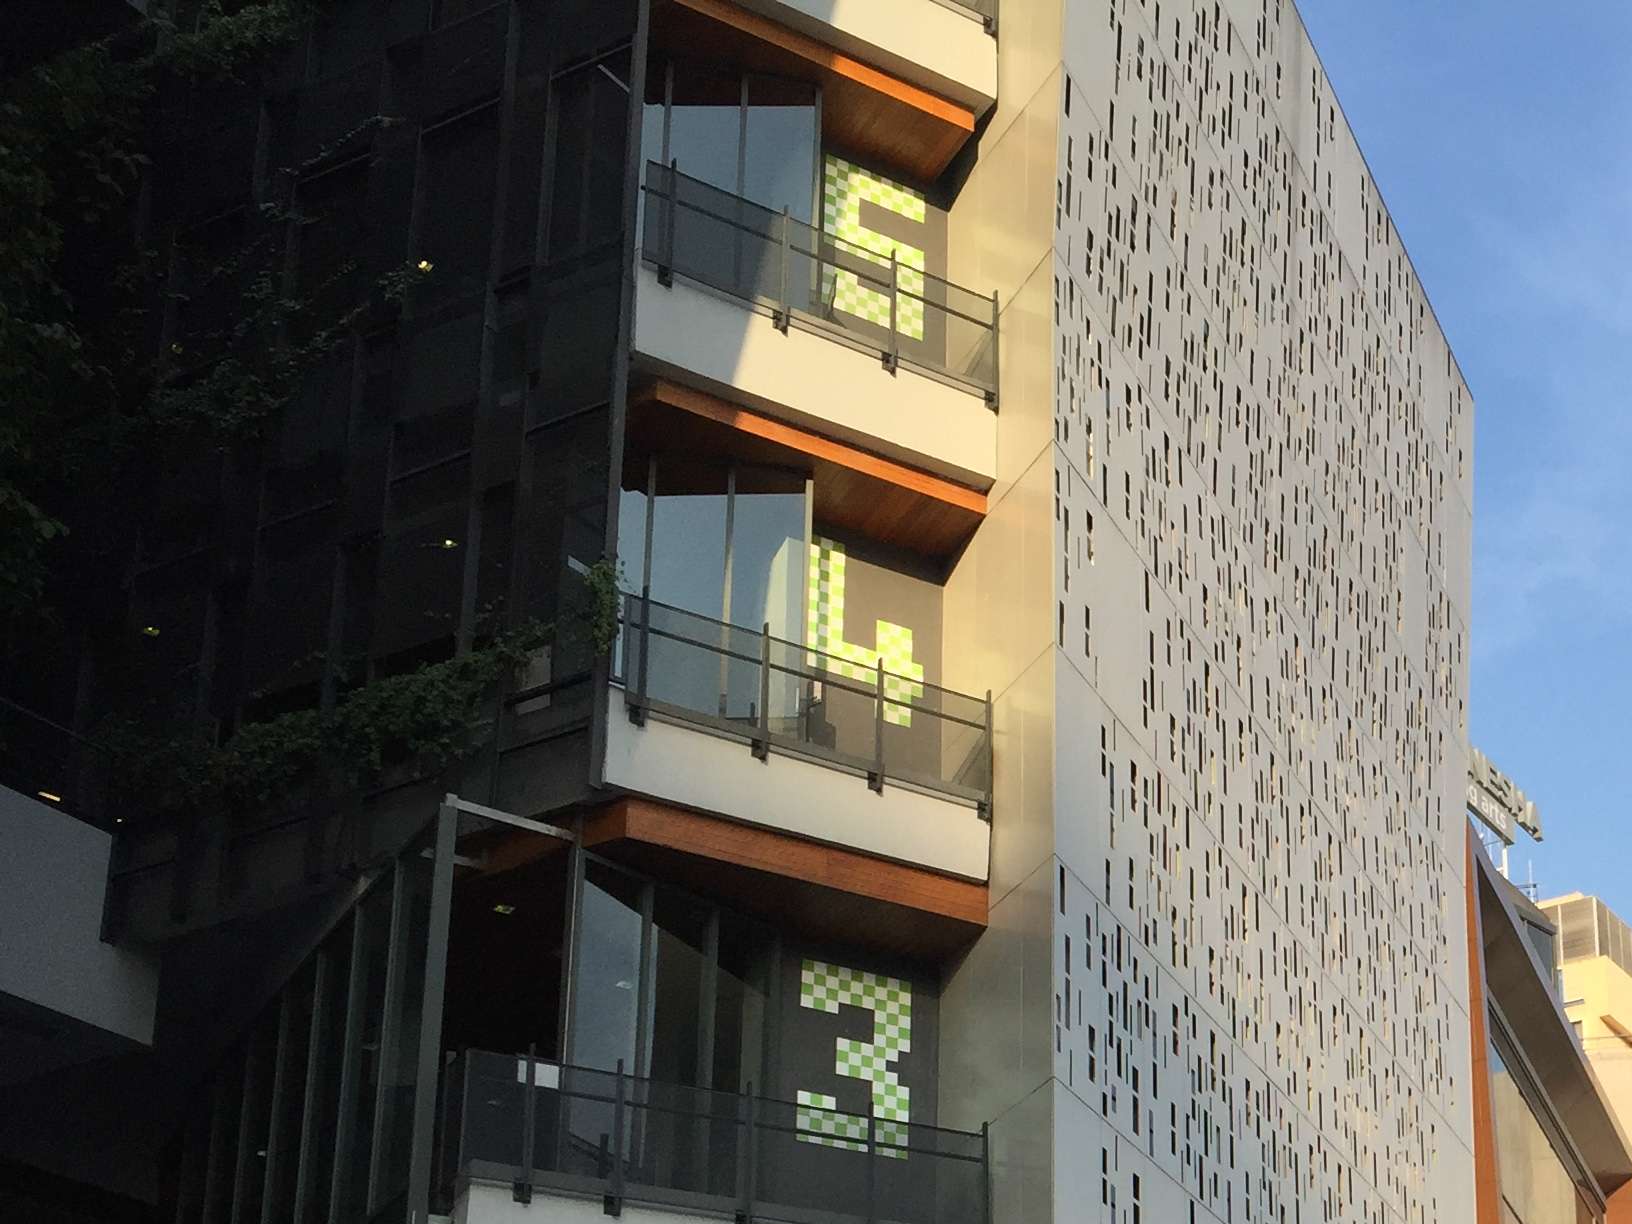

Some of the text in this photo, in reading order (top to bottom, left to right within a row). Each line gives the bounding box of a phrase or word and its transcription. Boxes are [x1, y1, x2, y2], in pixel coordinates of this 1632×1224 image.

[822, 152, 926, 341] 5
[807, 533, 926, 728] 4
[796, 957, 911, 1161] 3
